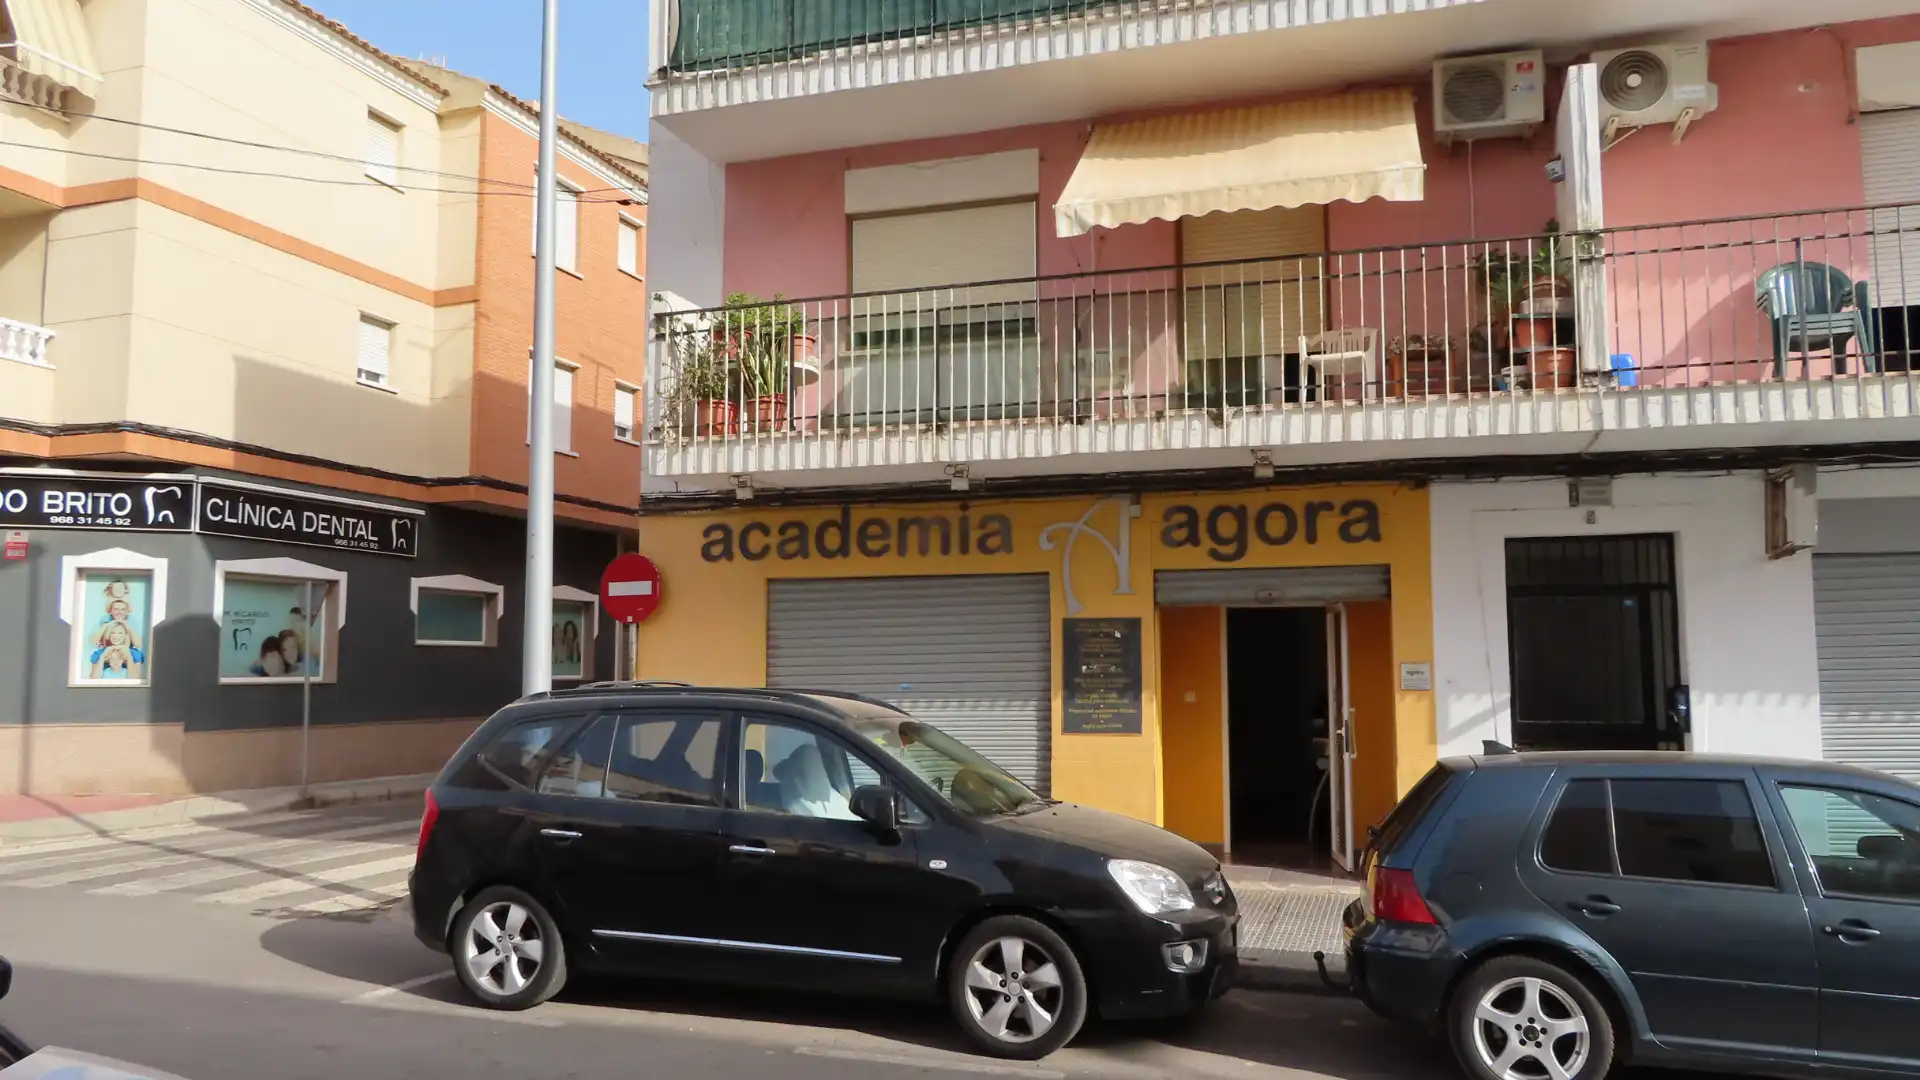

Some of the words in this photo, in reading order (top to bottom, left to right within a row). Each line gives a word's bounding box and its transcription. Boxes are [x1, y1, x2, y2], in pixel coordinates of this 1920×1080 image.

[0, 489, 28, 513] O
[43, 491, 132, 516] BRITO
[50, 516, 74, 524] 968
[77, 516, 92, 525] 31
[96, 518, 113, 526] 45
[115, 518, 131, 526] 92
[206, 496, 296, 531] CLÍNICA
[302, 511, 378, 541] DENTAL
[701, 502, 1013, 563] academia
[1160, 498, 1382, 562] agora
[369, 542, 379, 550] 92
